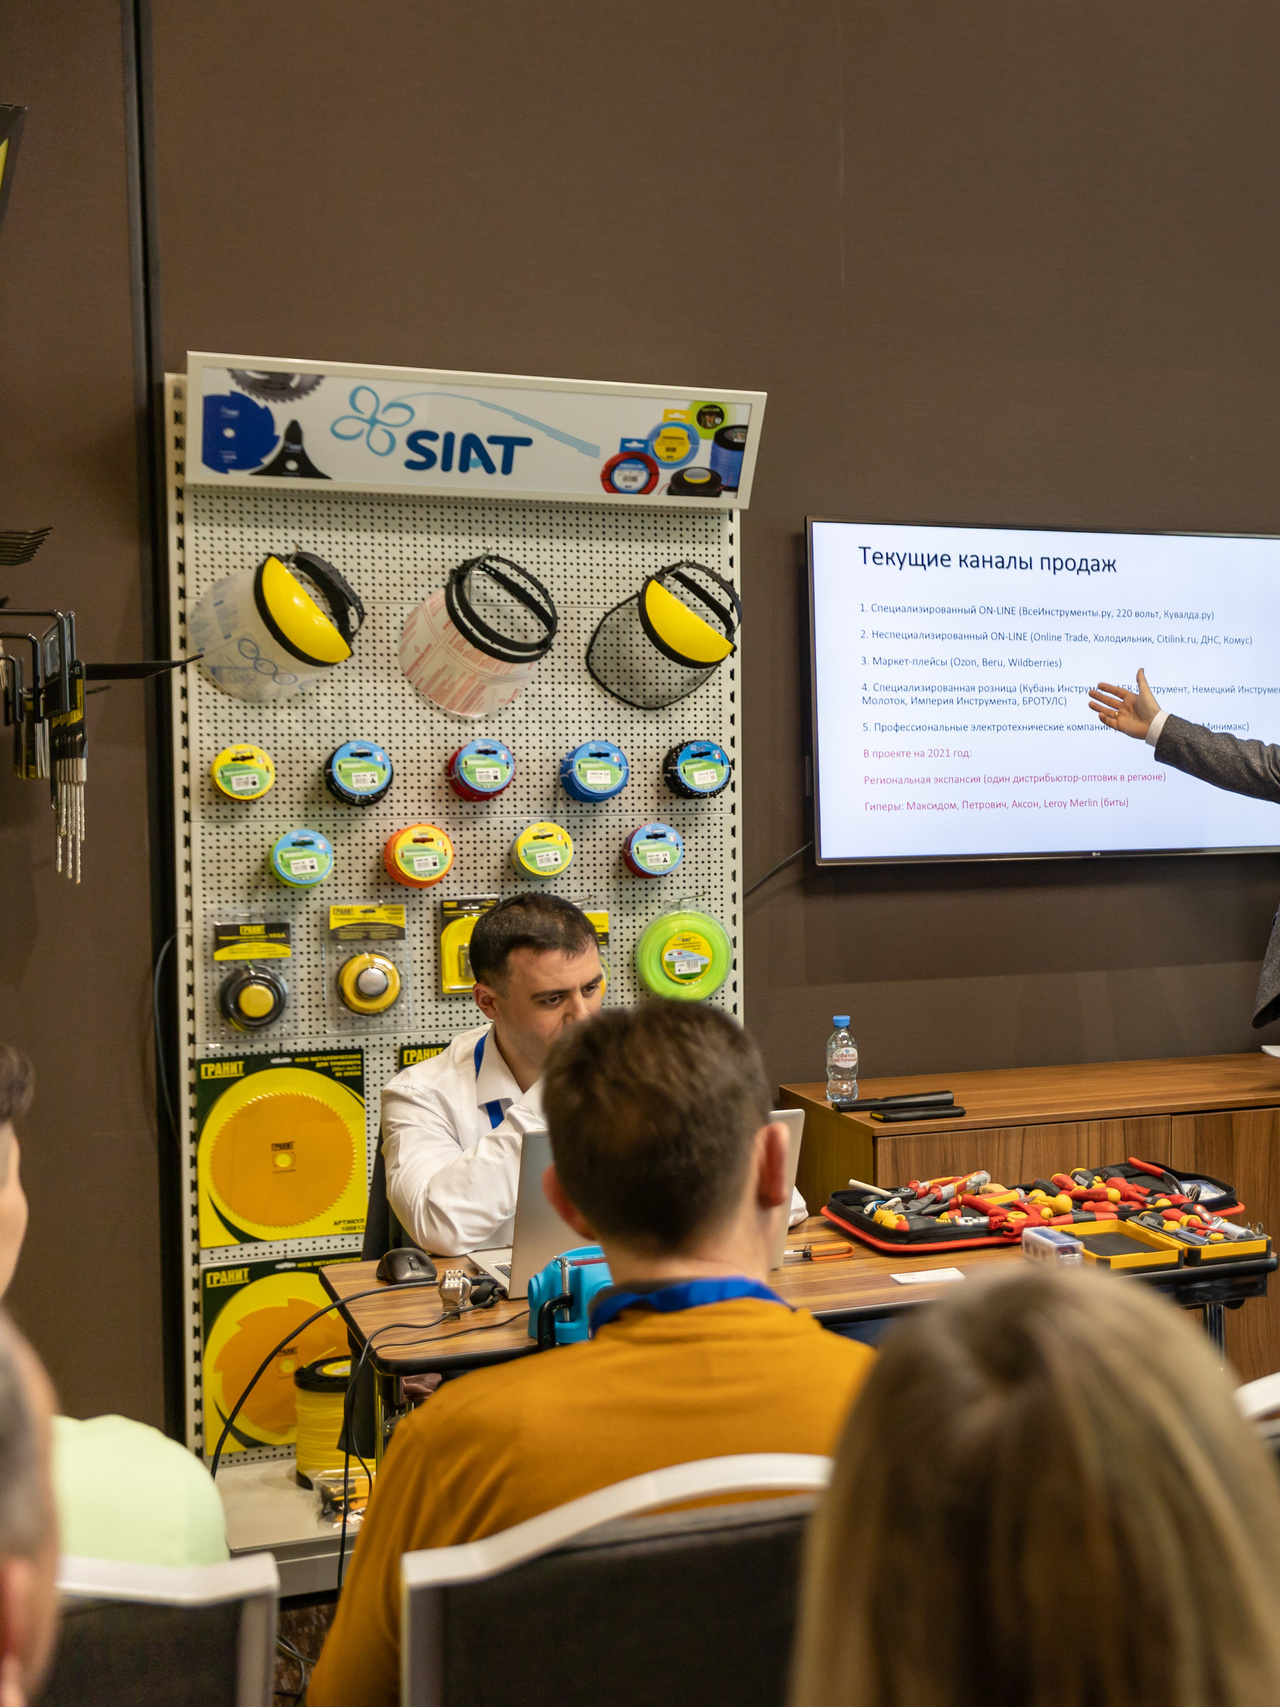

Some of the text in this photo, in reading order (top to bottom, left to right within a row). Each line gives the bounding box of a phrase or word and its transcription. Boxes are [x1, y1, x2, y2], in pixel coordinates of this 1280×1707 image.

[404, 429, 533, 476] SIAT
[858, 546, 1118, 576] Текущие каналы продаж
[860, 603, 1215, 622] 1. Специализированный ON-LINE (ВсеИнструменты.ру, 220 вольт, Кувалда.ру)
[860, 630, 1253, 646] 2. Неспециализированный ON-LINE (Online Trade, Холодильник, Citilink.ru, ДНС, Комус)
[861, 656, 1063, 669] 3. Маркет-плейсы (Ozon, Beru, Wildberries)
[861, 683, 871, 692] 4.
[873, 683, 976, 694] Специализированная
[978, 685, 1017, 694] розница
[1019, 684, 1056, 694] (Кубань
[1192, 684, 1235, 695] Немецкий
[861, 696, 1067, 707] Молоток, Империя Инструмента, БРОТУЛС)
[862, 723, 871, 732] 5.
[874, 722, 969, 733] Профессиональные
[971, 723, 1064, 733] электротехнические
[863, 749, 972, 760] В проекте на 2021 год:
[864, 772, 1167, 785] Региональная экспансия (один дистрибьютор-оптовик в регионе)
[864, 797, 1129, 812] Гиперы: Максидом, Петрович, Аксон, Leroy Merlin (биты)
[200, 1060, 245, 1079] ГРАНИТ
[206, 1267, 250, 1288] ГРАНИТ
